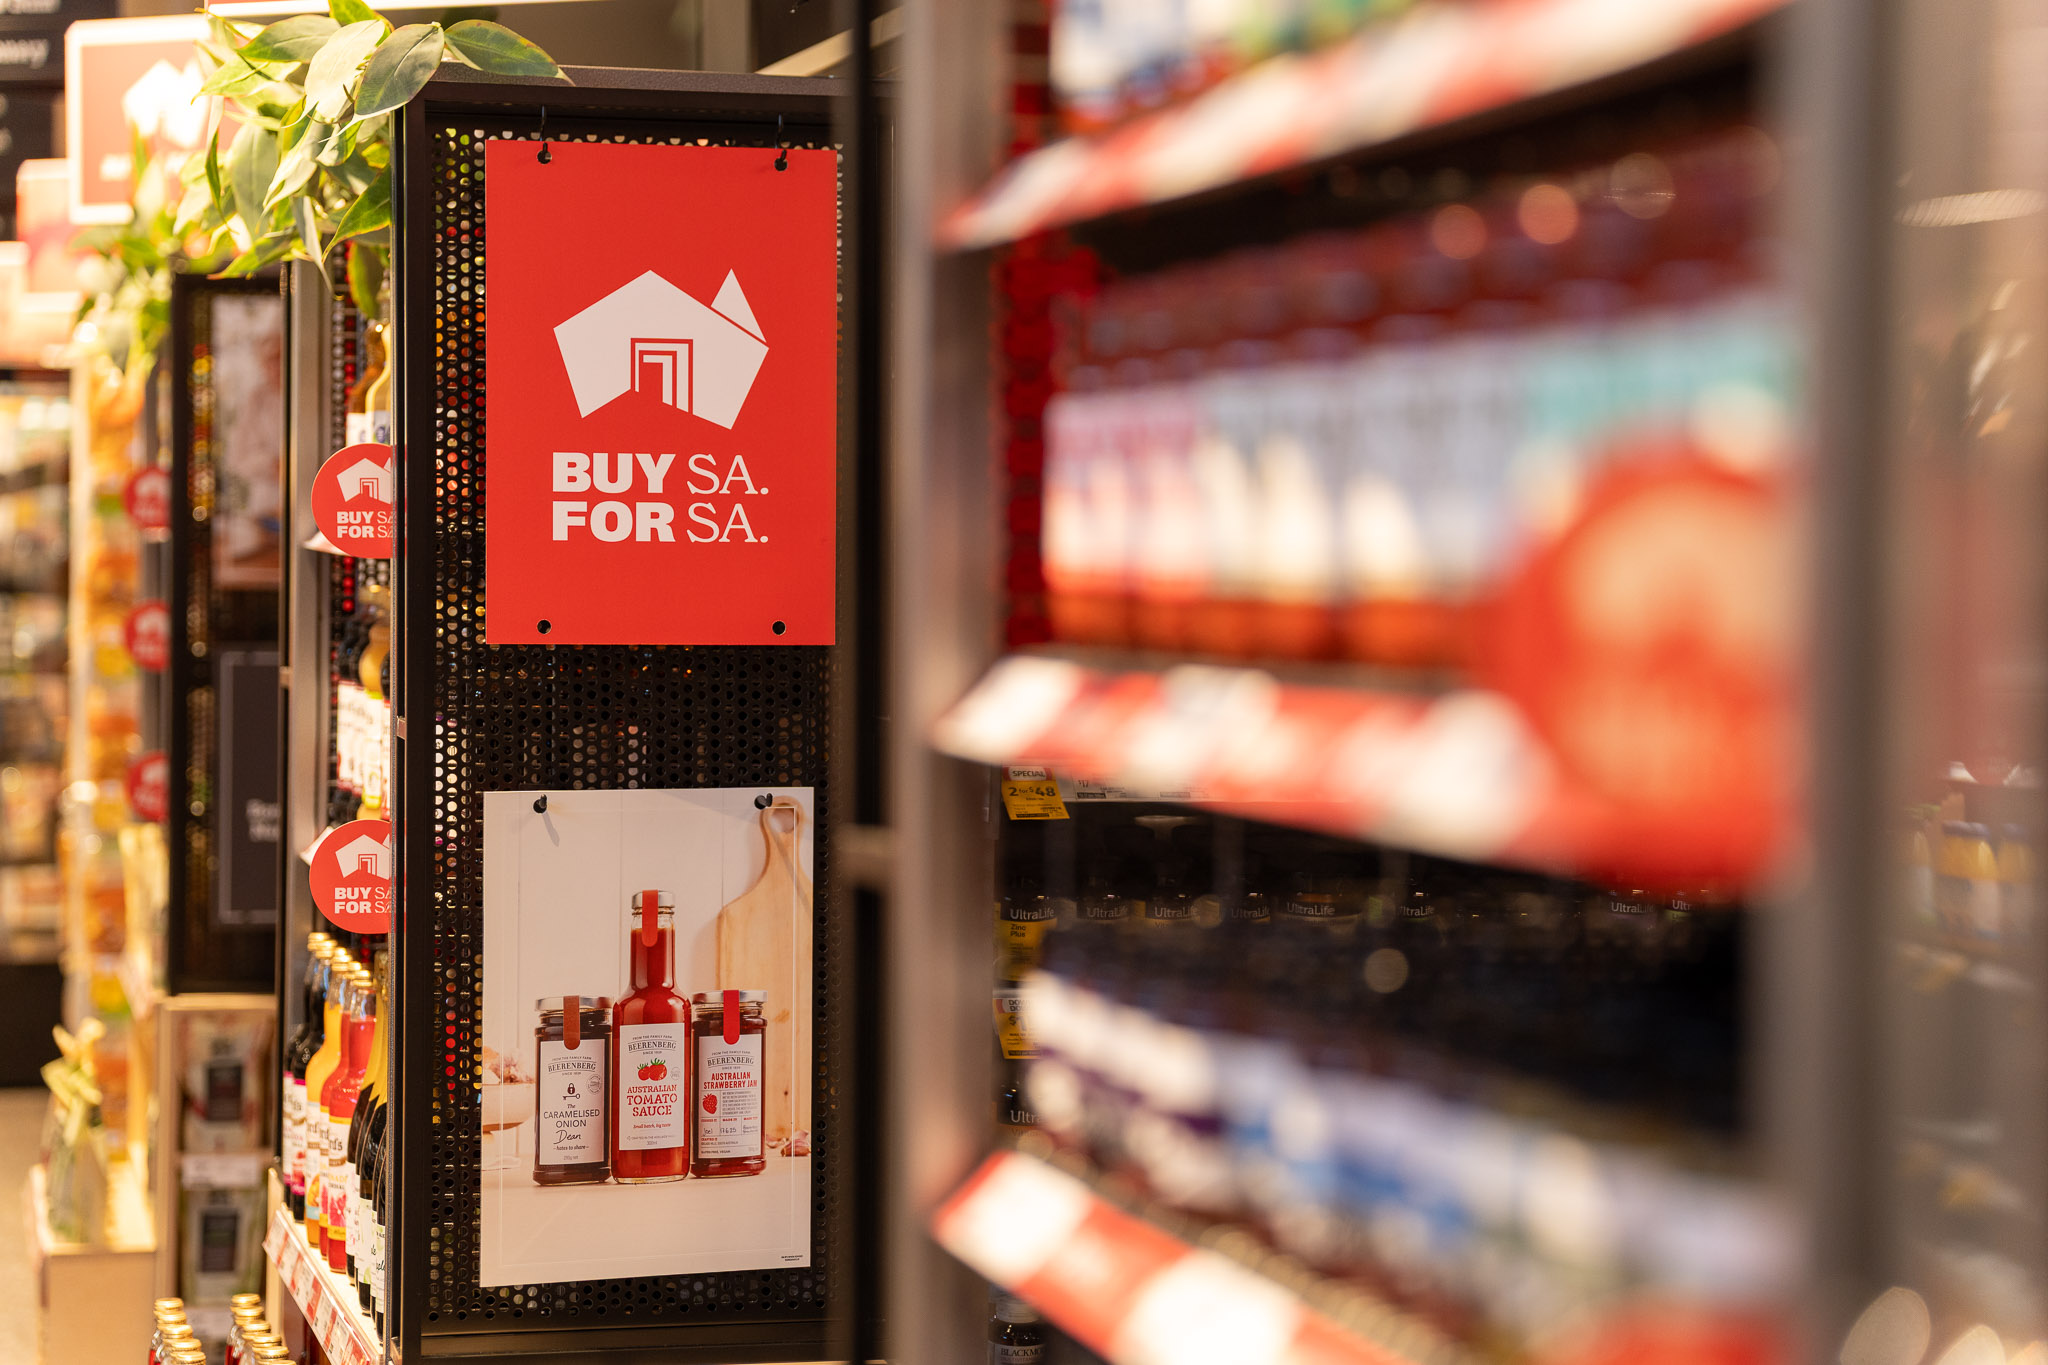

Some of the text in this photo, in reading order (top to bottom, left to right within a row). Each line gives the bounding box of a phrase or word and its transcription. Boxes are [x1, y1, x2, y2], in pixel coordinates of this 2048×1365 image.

[552, 452, 769, 495] BUY SA.
[336, 511, 375, 524] BUY
[552, 500, 769, 543] FOR SA.
[337, 525, 375, 539] FOR
[1012, 770, 1046, 778] SPECIAL
[1008, 787, 1019, 797] 2
[334, 886, 373, 900] BUY
[334, 900, 373, 914] FOR
[1286, 902, 1335, 916] UltraLife
[1009, 905, 1055, 921] UltraLife
[1010, 923, 1026, 931] Zinc
[627, 1041, 677, 1052] BEERENBERG
[707, 1056, 754, 1067] BEERENBERG
[547, 1062, 597, 1073] BEERENBERG
[711, 1072, 751, 1081] AUSTRALIAN
[627, 1084, 677, 1094] AUSTRALIAN
[703, 1079, 758, 1090] STRAWBERRY JAM
[626, 1093, 678, 1105] TOMATO
[543, 1108, 600, 1119] CARAMELISED
[632, 1105, 672, 1117] SAUCE
[556, 1119, 587, 1128] ONION
[553, 1129, 582, 1145] Dean
